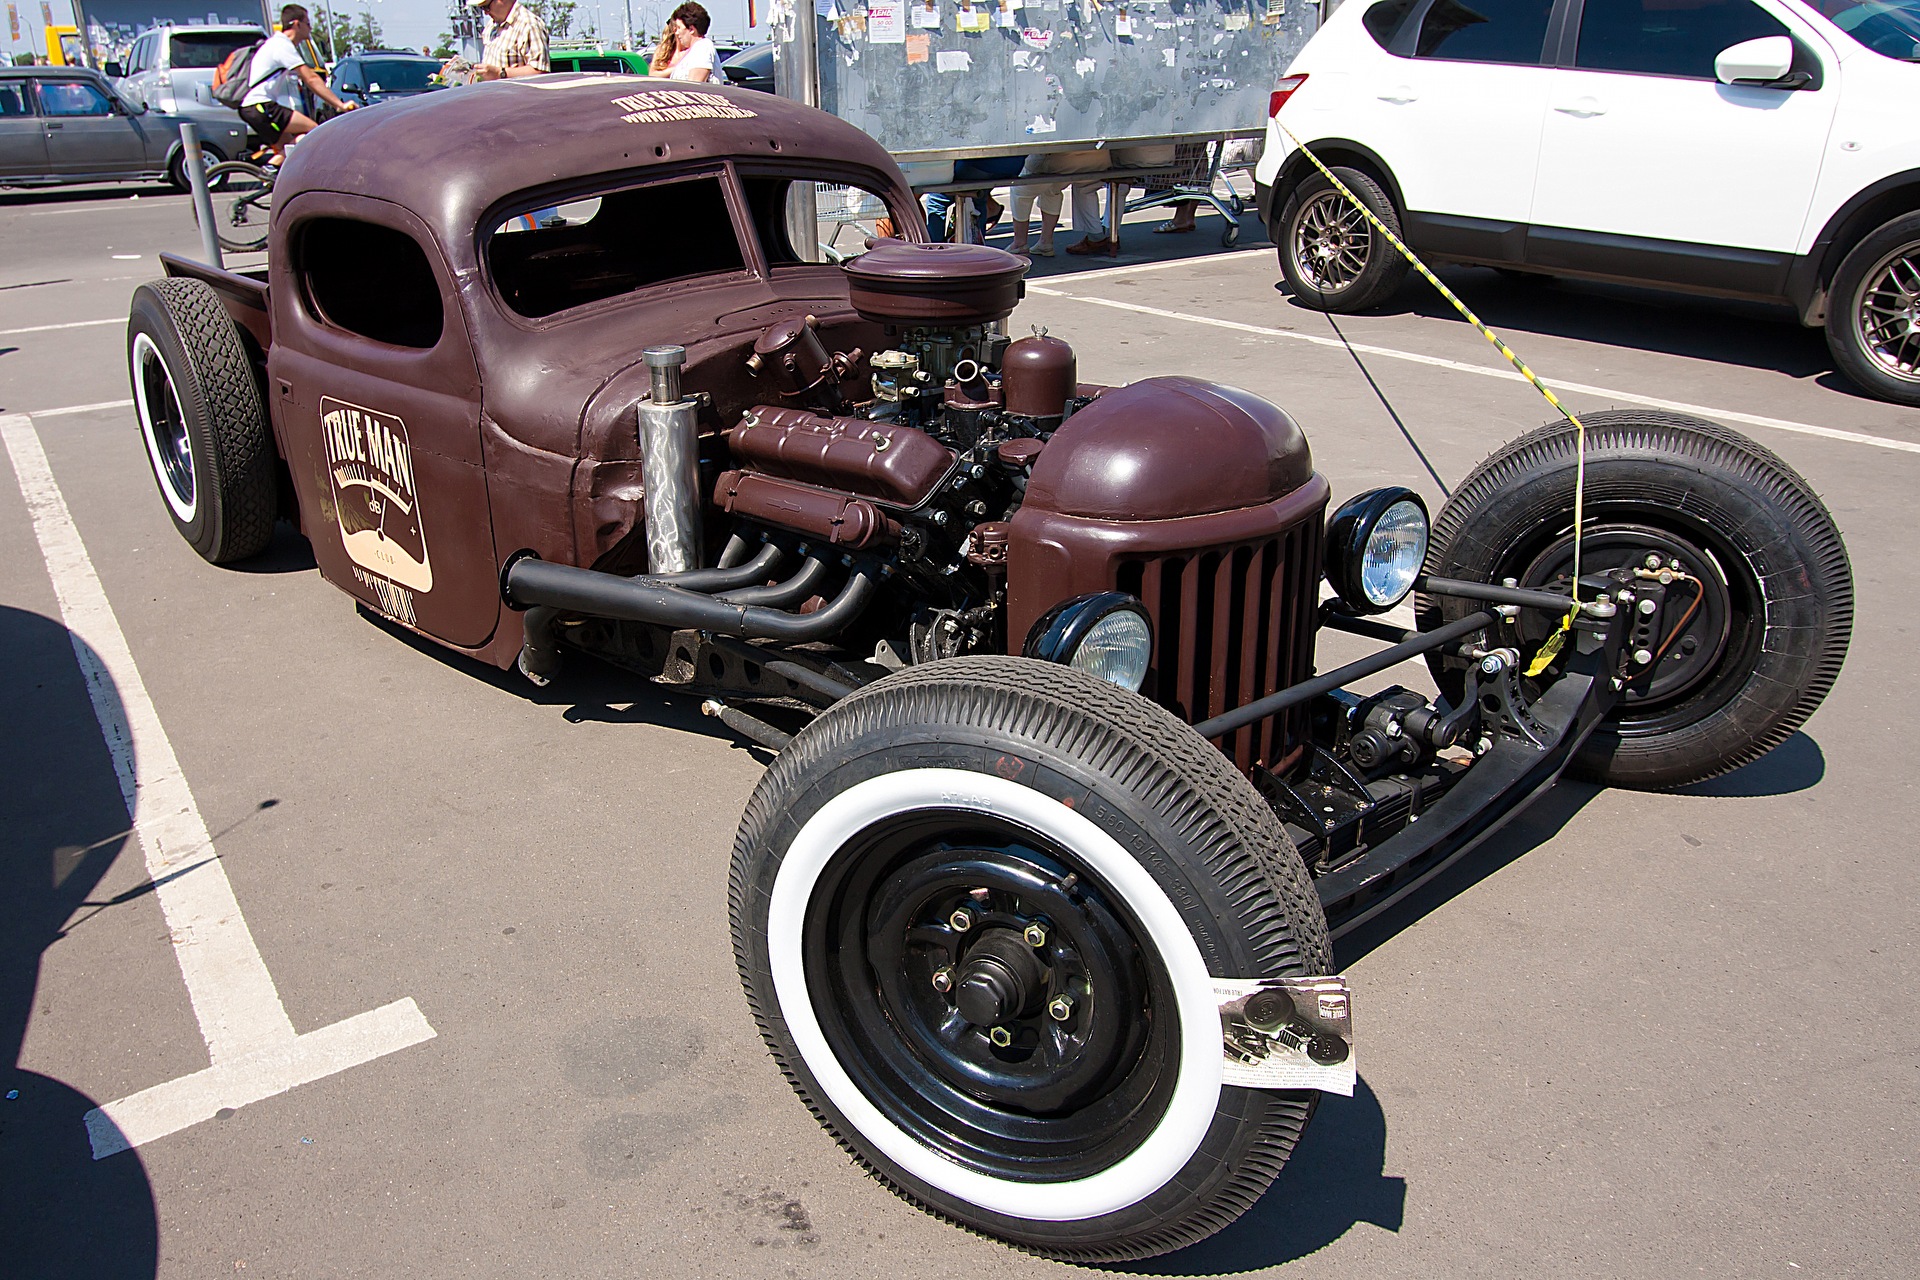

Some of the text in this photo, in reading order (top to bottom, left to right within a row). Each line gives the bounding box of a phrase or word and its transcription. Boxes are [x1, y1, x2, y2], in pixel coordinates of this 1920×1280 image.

[611, 92, 666, 112] TRUE
[649, 90, 700, 106] FOR
[323, 409, 413, 496] TRUE MAN
[369, 500, 382, 514] dB
[940, 791, 991, 807] ATLAS
